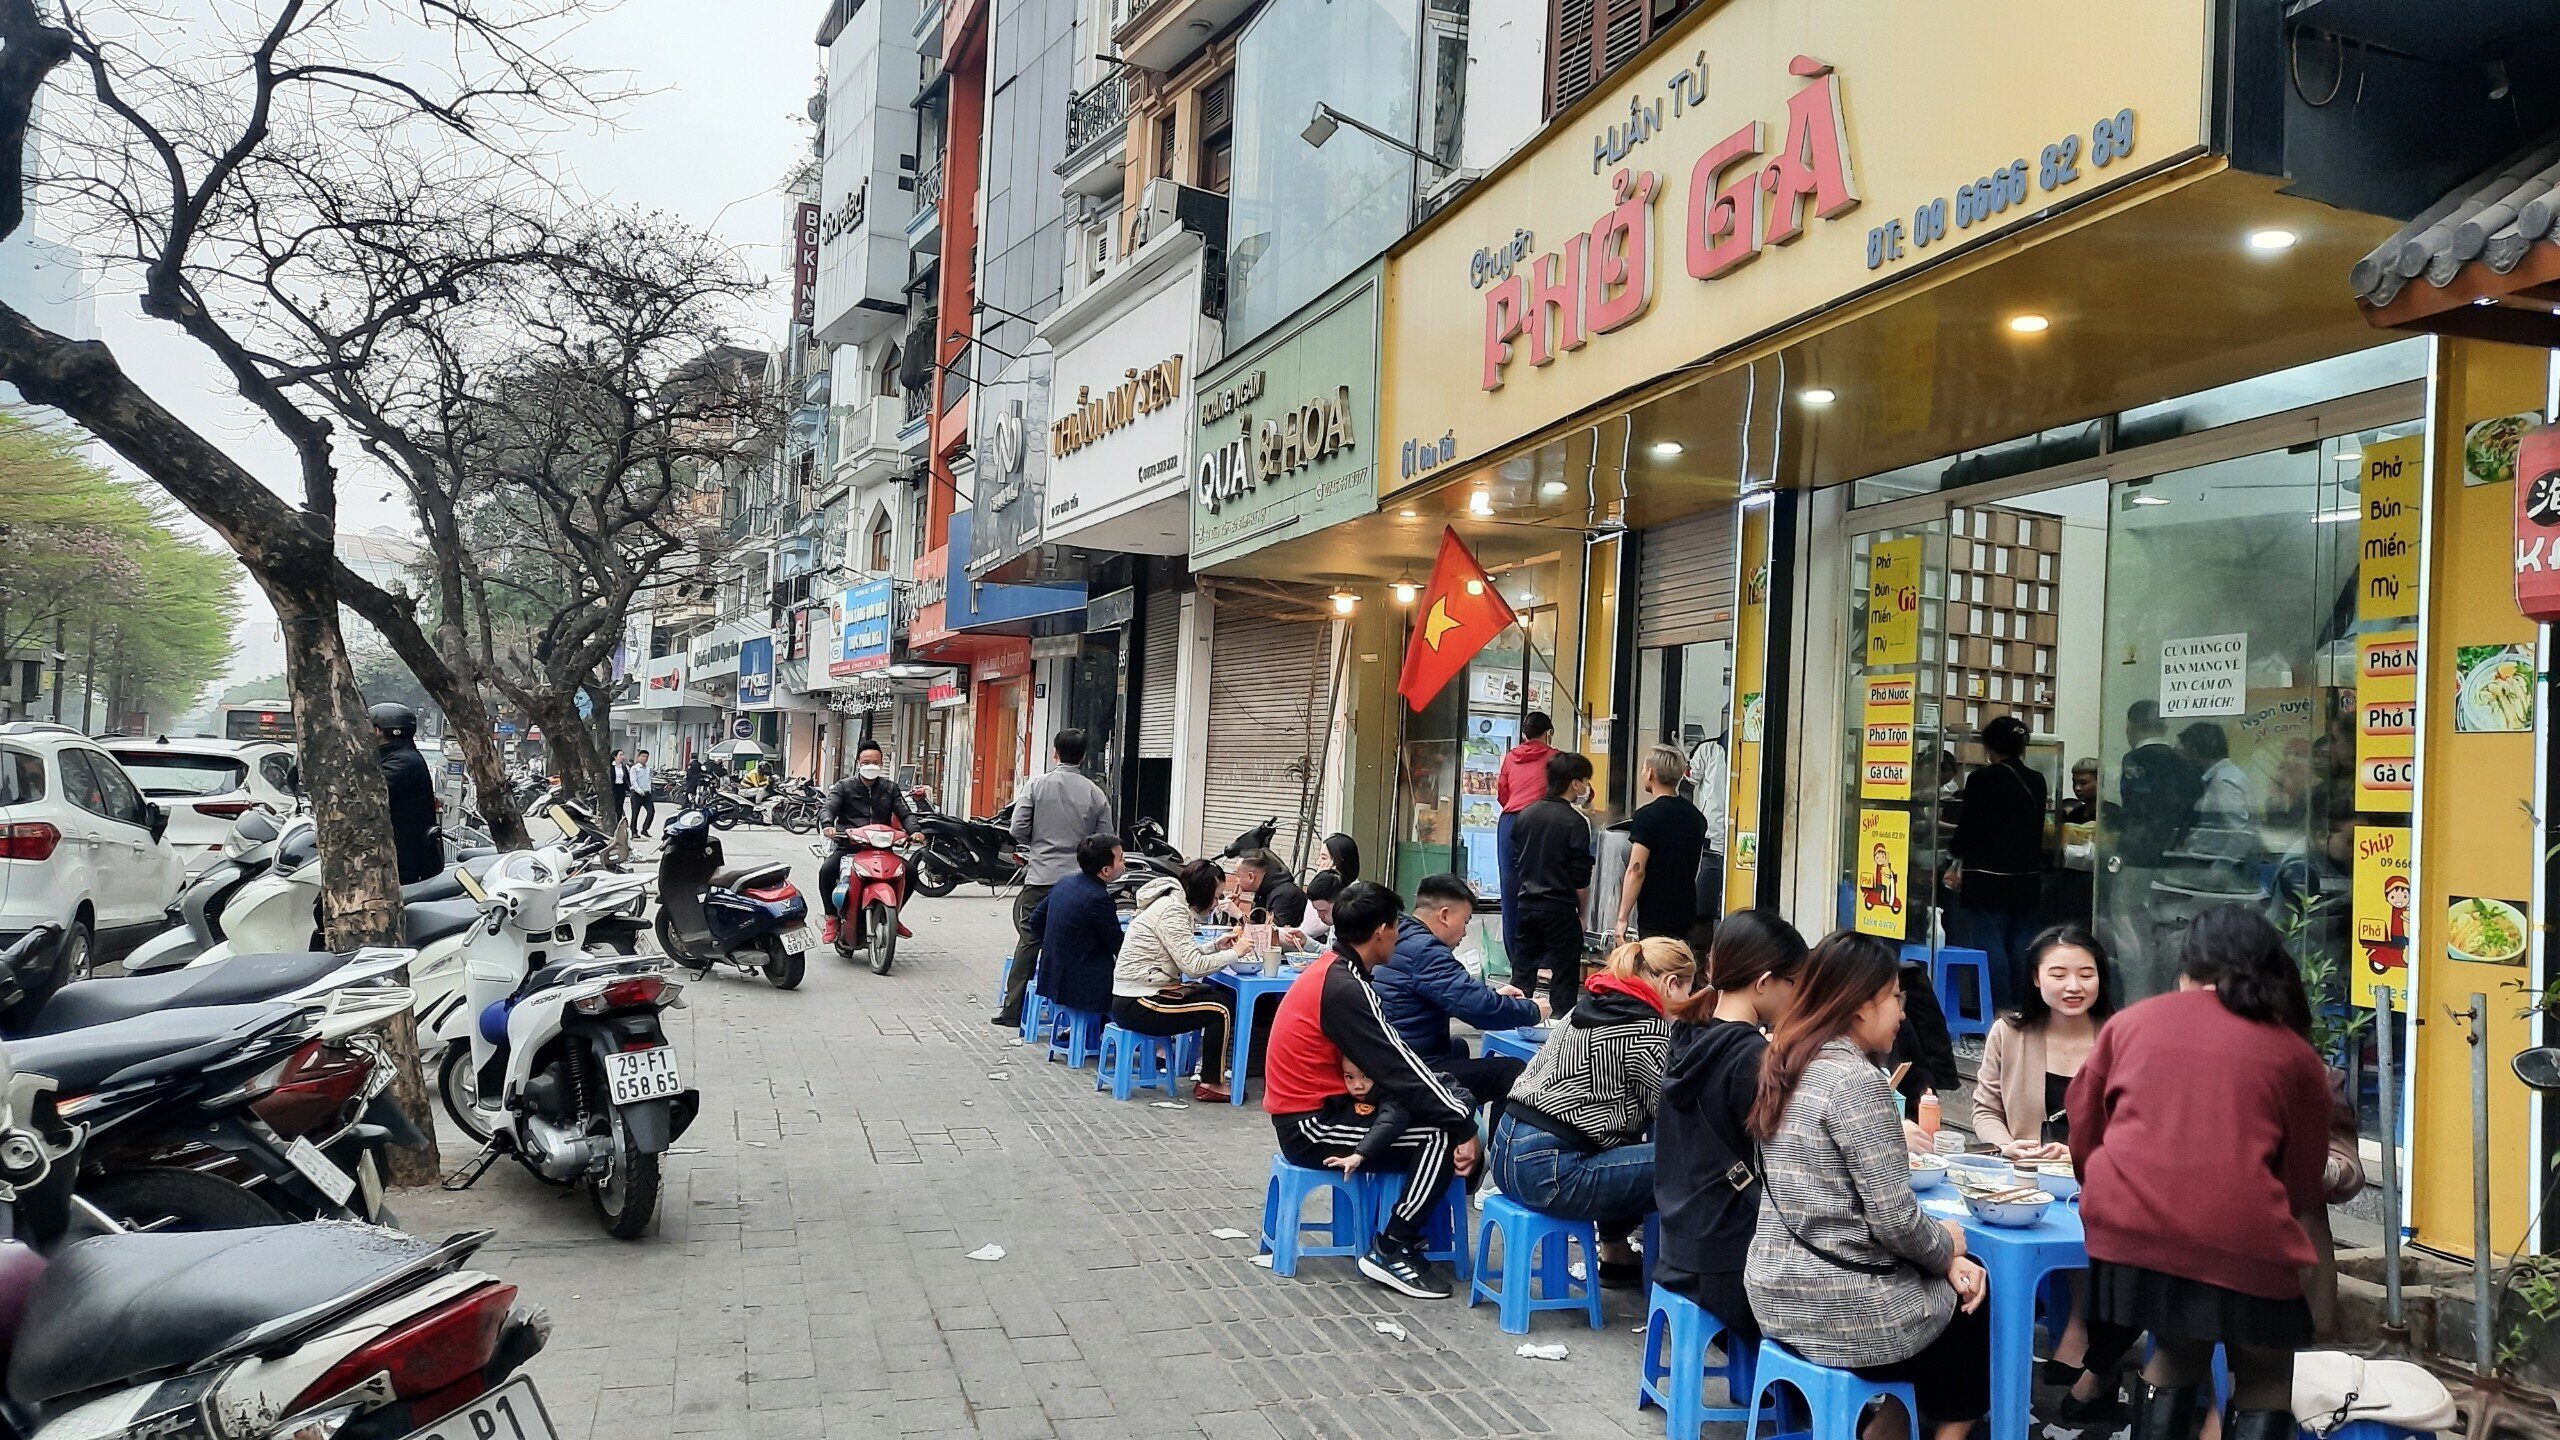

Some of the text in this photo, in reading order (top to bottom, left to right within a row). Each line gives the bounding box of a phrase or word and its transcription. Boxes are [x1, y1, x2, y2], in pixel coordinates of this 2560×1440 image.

[1593, 49, 1709, 176] HUẤN TÚ
[1914, 197, 1949, 247] 09
[1955, 158, 2029, 218] 6666
[2039, 133, 2081, 191] 82
[2091, 107, 2136, 168] 89
[1482, 54, 1862, 392] PHỞ GÀ
[1469, 228, 1535, 290] Chuyên
[1051, 385, 1104, 460] THẨM
[1138, 354, 1184, 416] SEN
[1199, 384, 1356, 516] QUẢ & HOA
[1402, 437, 1417, 480] 61
[2371, 455, 2403, 482] Phở
[2370, 496, 2401, 520] Bún
[2364, 532, 2406, 560] Miến
[1874, 582, 1890, 597] Bún
[1898, 585, 1917, 612] Gà
[2188, 660, 2222, 673] MANG
[2370, 649, 2402, 669] Phở
[1871, 687, 1909, 701] Phở Nước
[2169, 681, 2187, 692] XIN
[2369, 707, 2404, 728] Phở
[1869, 727, 1907, 743] Phở Trộn
[1870, 766, 1882, 779] Gà
[2373, 763, 2397, 783] Gà
[1863, 813, 1880, 832] Ship
[2360, 832, 2394, 861] Ship
[2380, 857, 2393, 867] 09
[2362, 924, 2381, 937] Phở
[618, 1051, 667, 1077] 29-F1
[616, 1071, 678, 1100] 658.65
